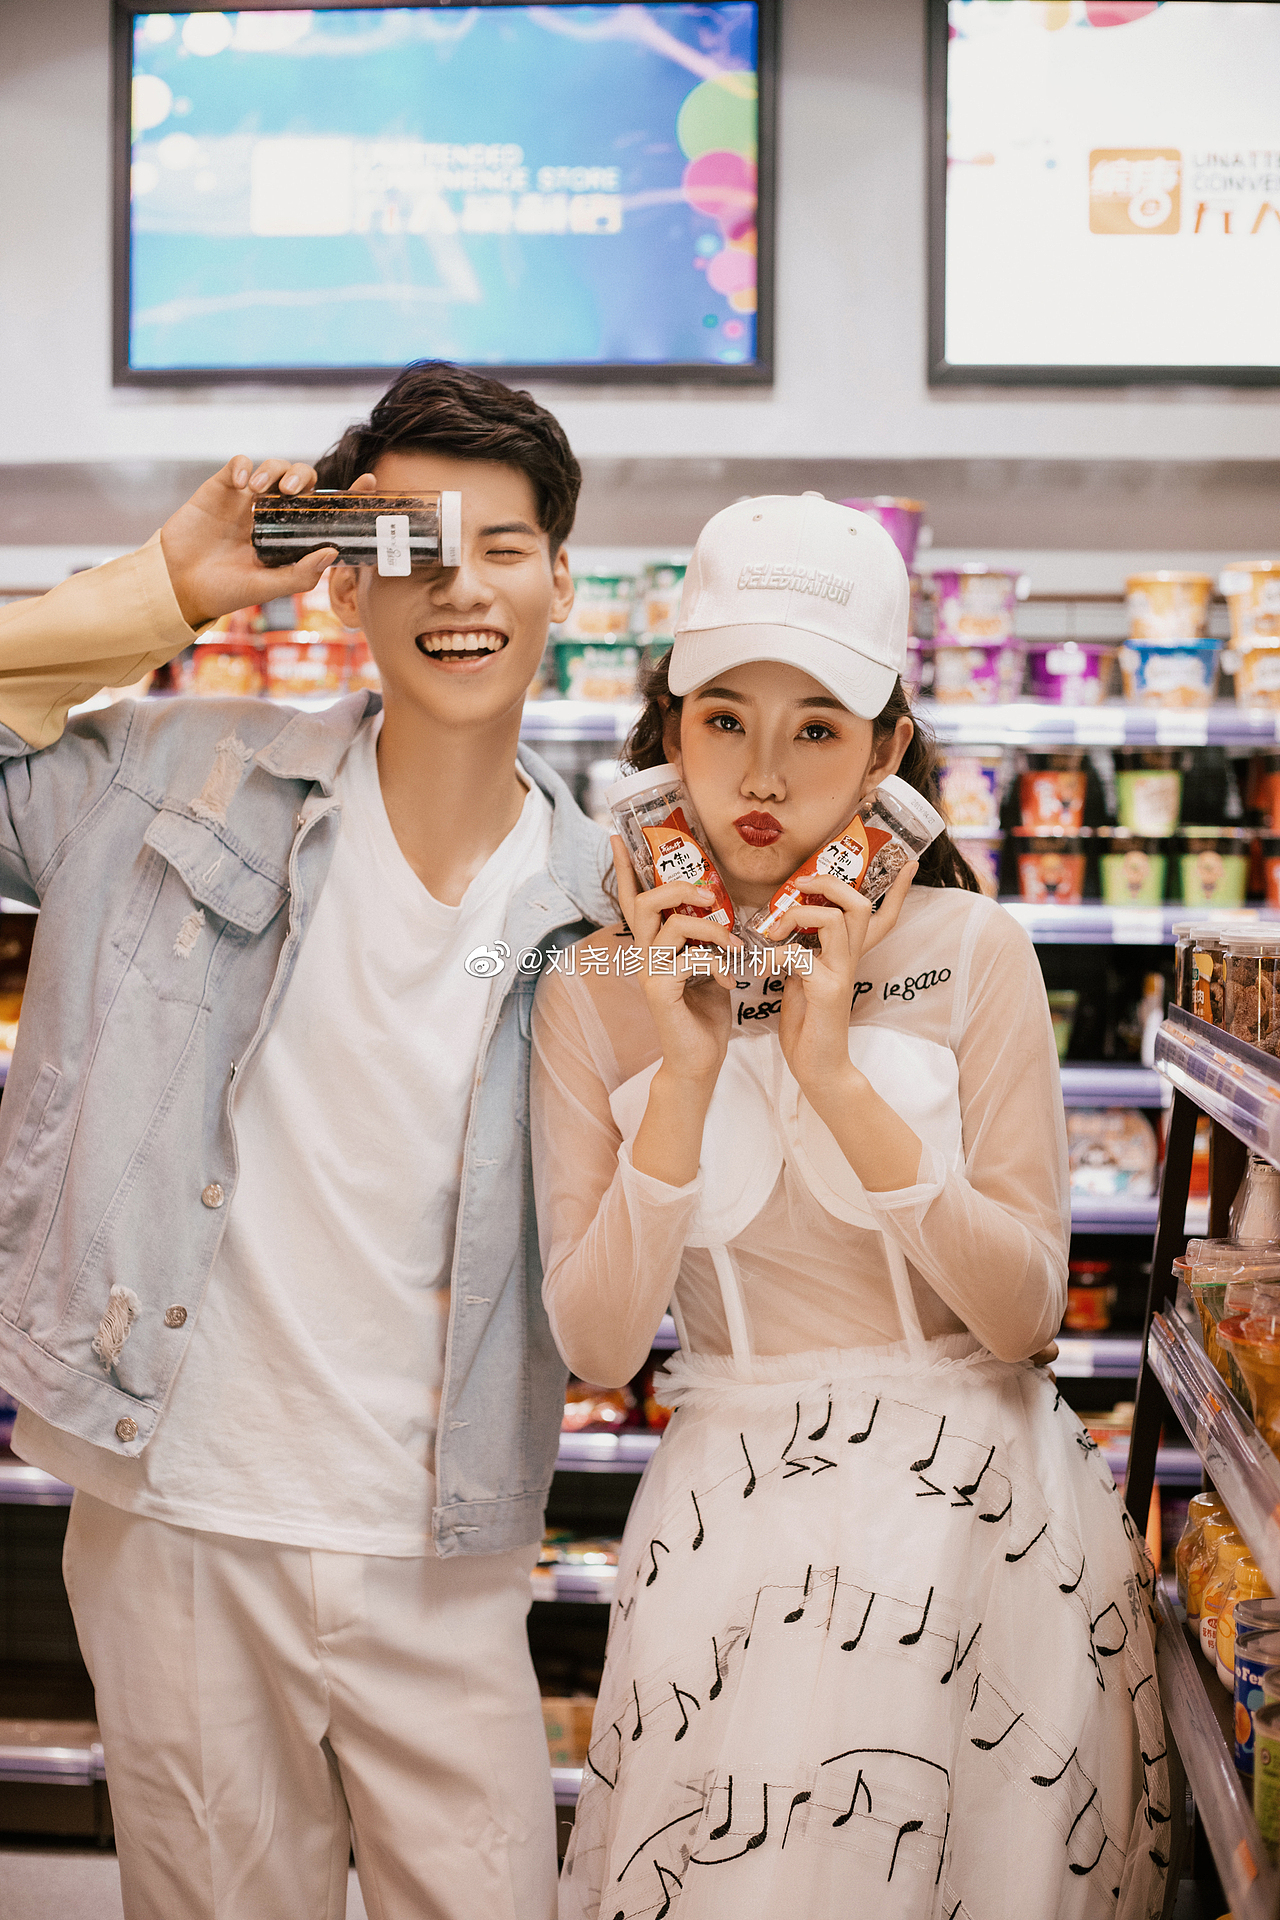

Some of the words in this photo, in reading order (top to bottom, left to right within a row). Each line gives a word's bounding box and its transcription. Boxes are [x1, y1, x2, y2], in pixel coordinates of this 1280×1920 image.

[737, 563, 855, 606] CELEBRATION
[659, 852, 690, 872] 九制
[827, 844, 852, 866] 九制
[681, 857, 710, 880] 话梅
